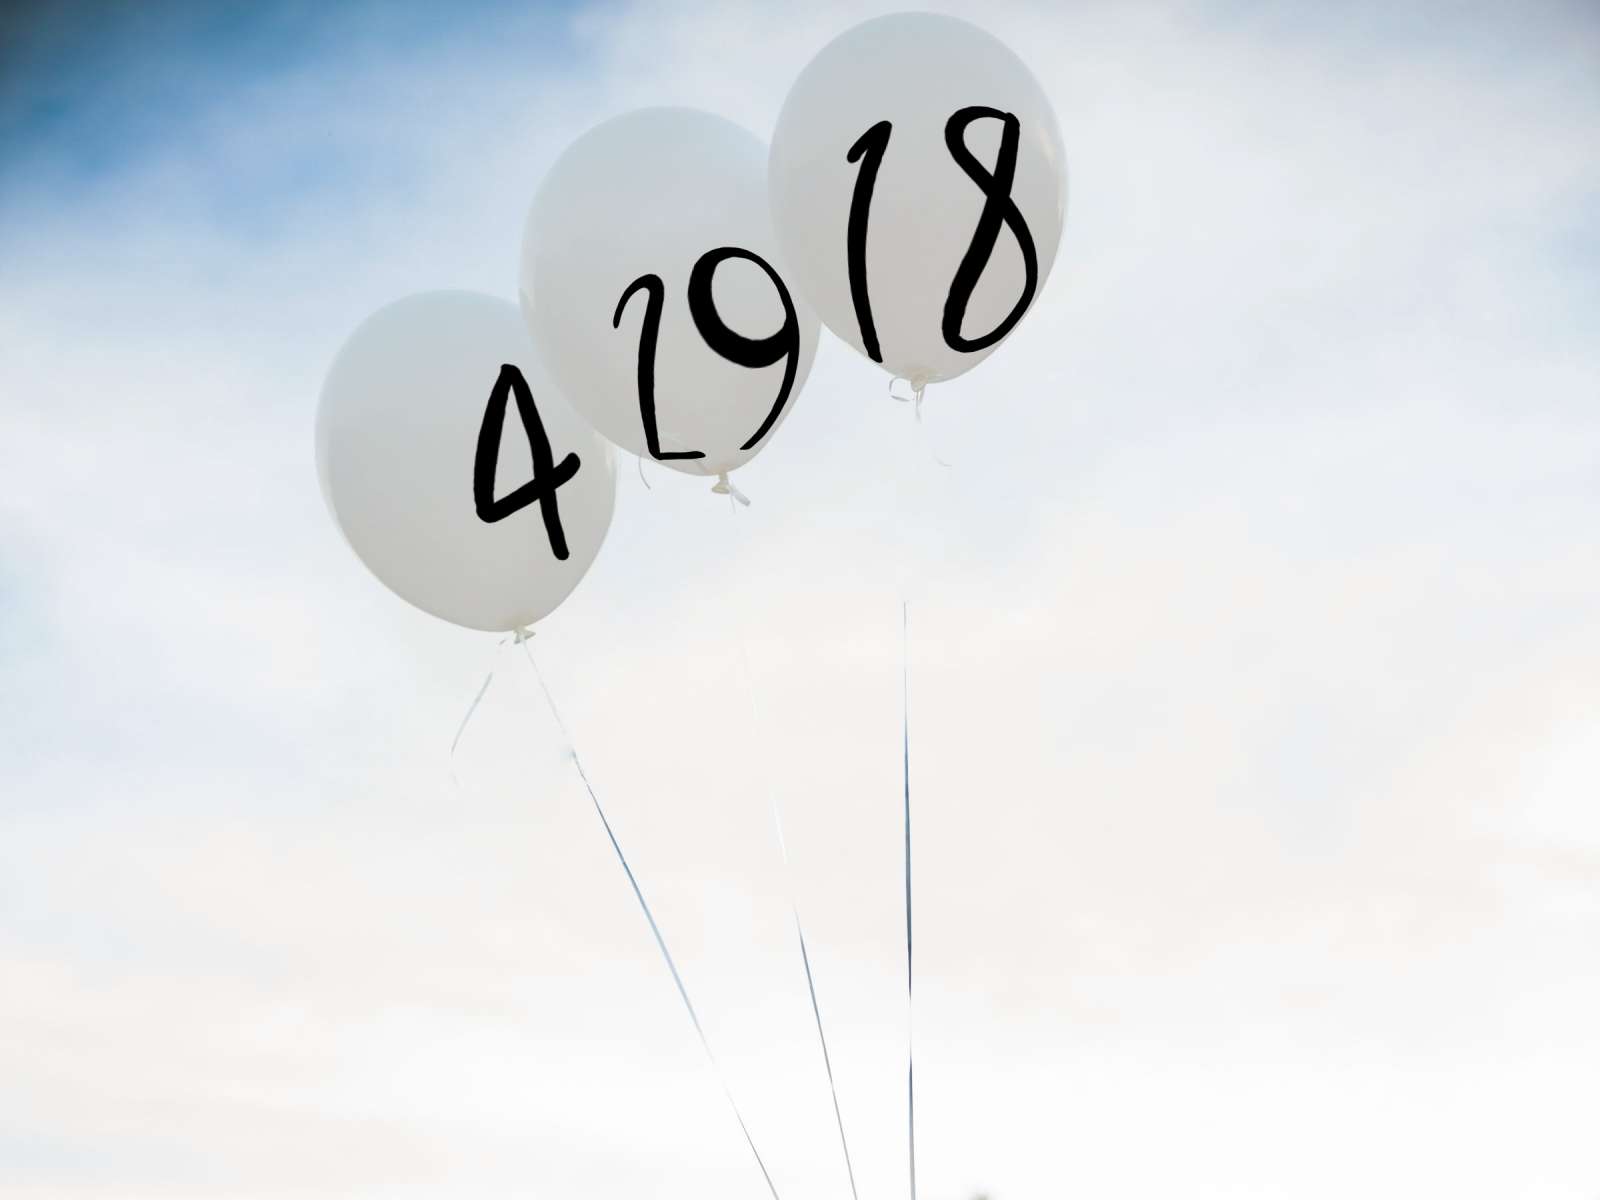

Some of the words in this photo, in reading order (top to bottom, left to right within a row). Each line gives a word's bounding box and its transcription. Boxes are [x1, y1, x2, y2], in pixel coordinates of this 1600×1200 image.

[846, 105, 1039, 364] 18
[612, 246, 801, 461] 29
[472, 363, 581, 561] 4
